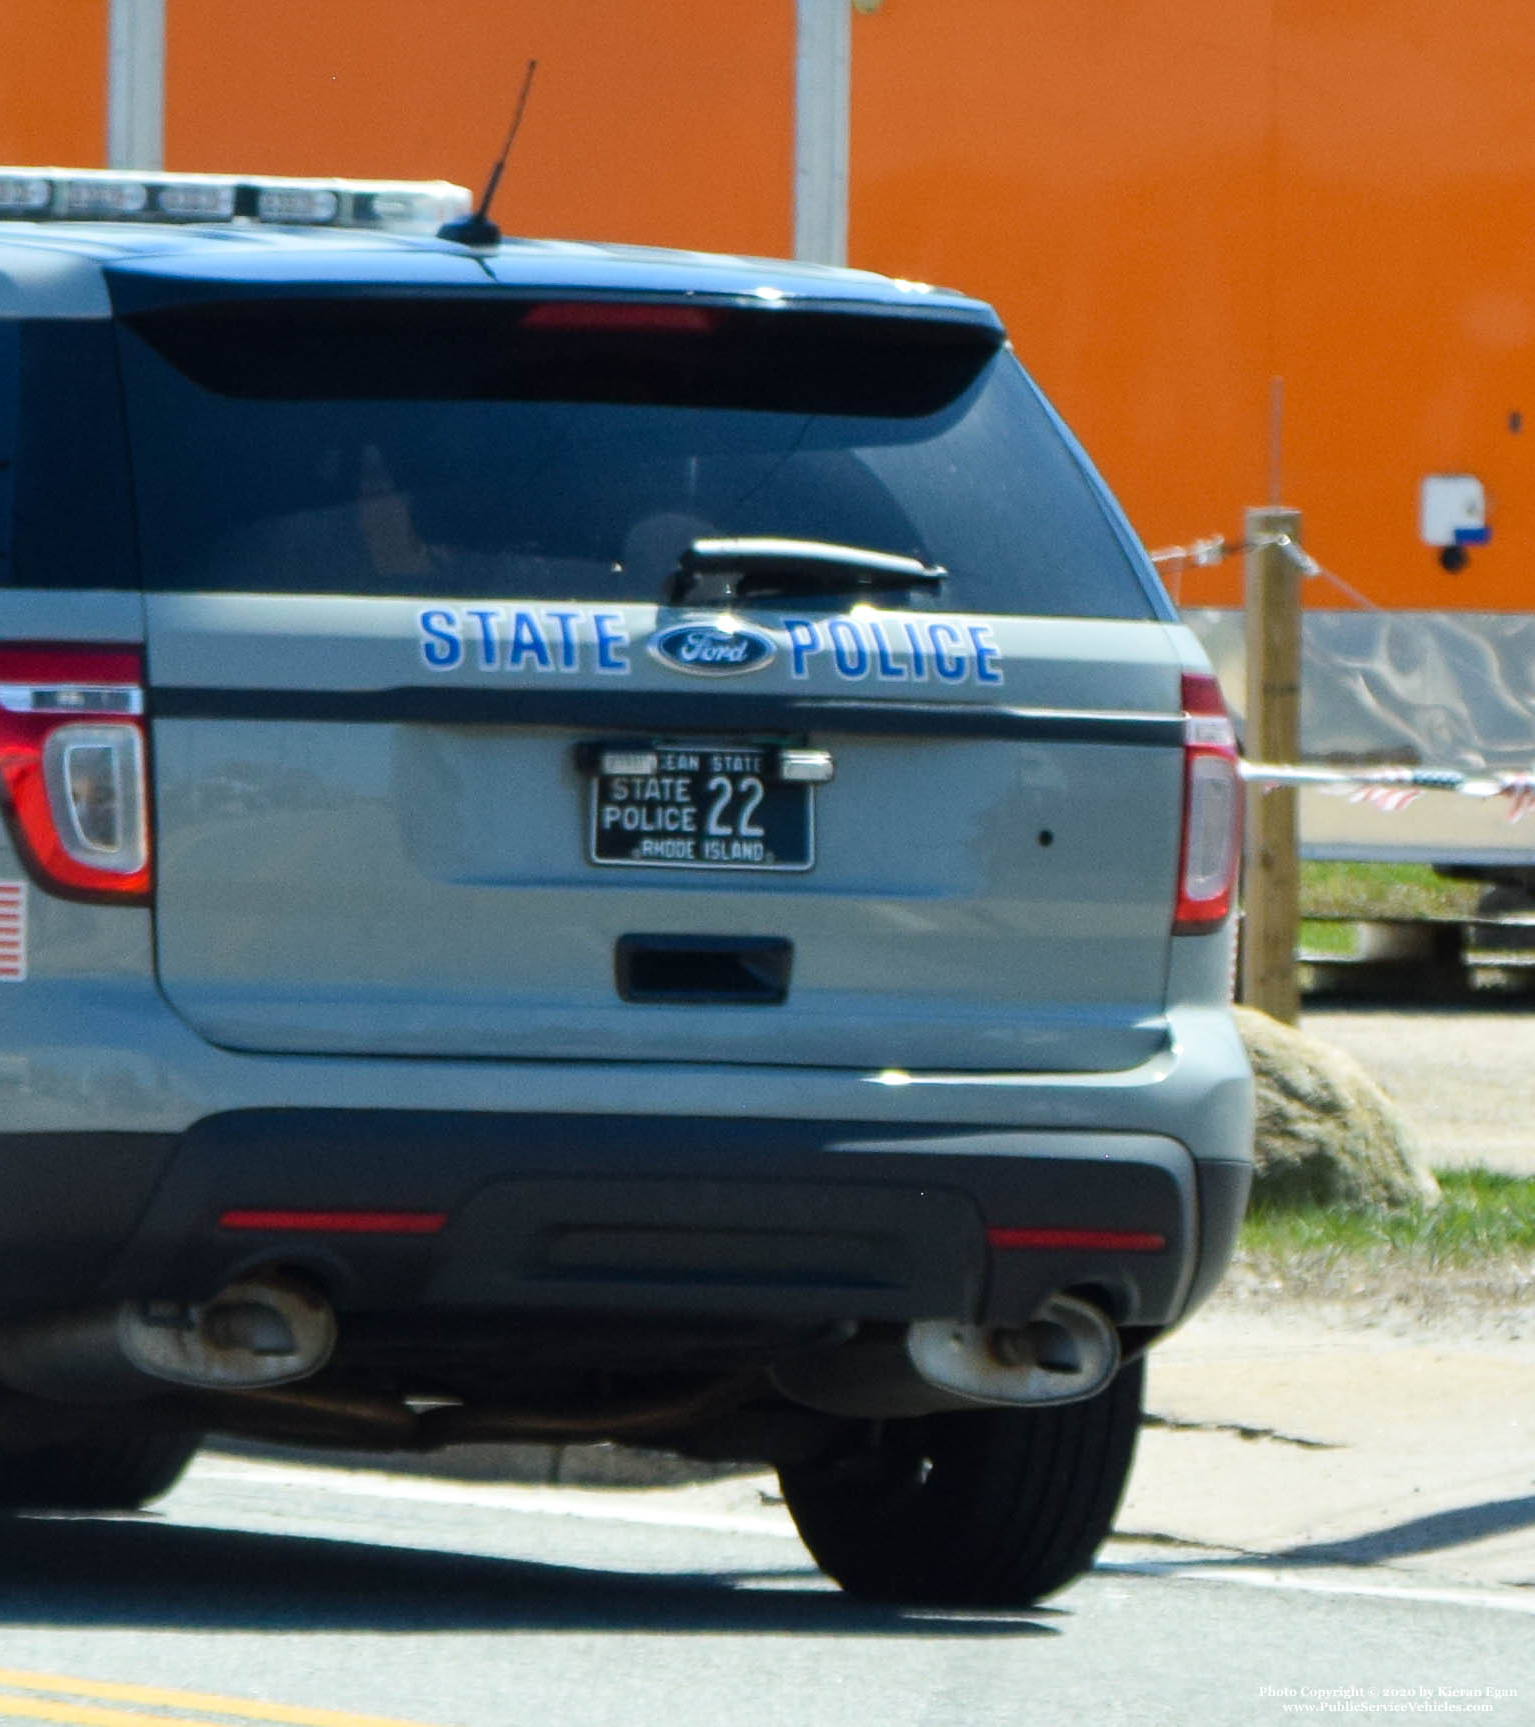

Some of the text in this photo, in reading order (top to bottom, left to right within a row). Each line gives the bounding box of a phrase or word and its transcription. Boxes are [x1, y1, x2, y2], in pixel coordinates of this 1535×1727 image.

[417, 606, 630, 675] STATE
[680, 632, 749, 663] Ford
[783, 617, 1005, 686] POLICE
[712, 753, 762, 773] STATE
[611, 777, 692, 802] STATE
[601, 804, 698, 833] POLICE
[706, 776, 765, 837] 22
[641, 839, 765, 863] RHODE ISLAND
